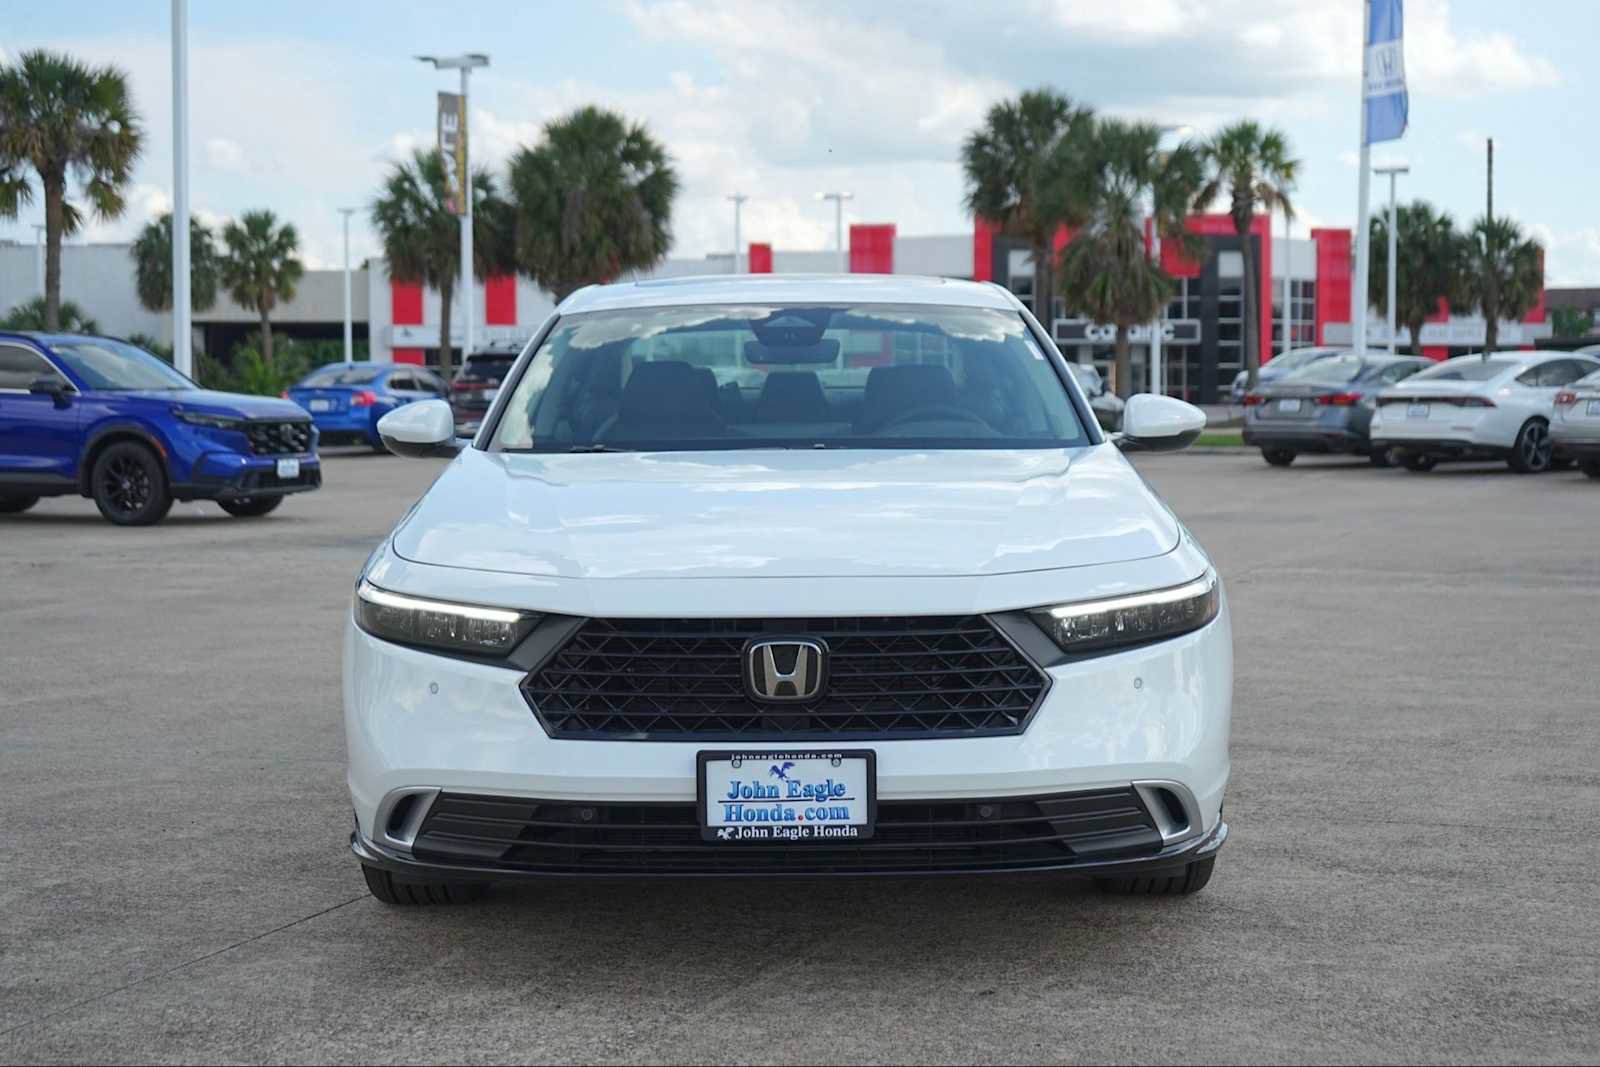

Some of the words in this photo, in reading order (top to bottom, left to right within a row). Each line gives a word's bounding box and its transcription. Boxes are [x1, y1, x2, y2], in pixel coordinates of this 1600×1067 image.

[727, 780, 780, 799] John
[786, 779, 846, 803] Eagle
[723, 804, 850, 822] Honda.com
[735, 826, 768, 839] John
[773, 826, 810, 840] Eagle
[814, 825, 858, 838] Honda
